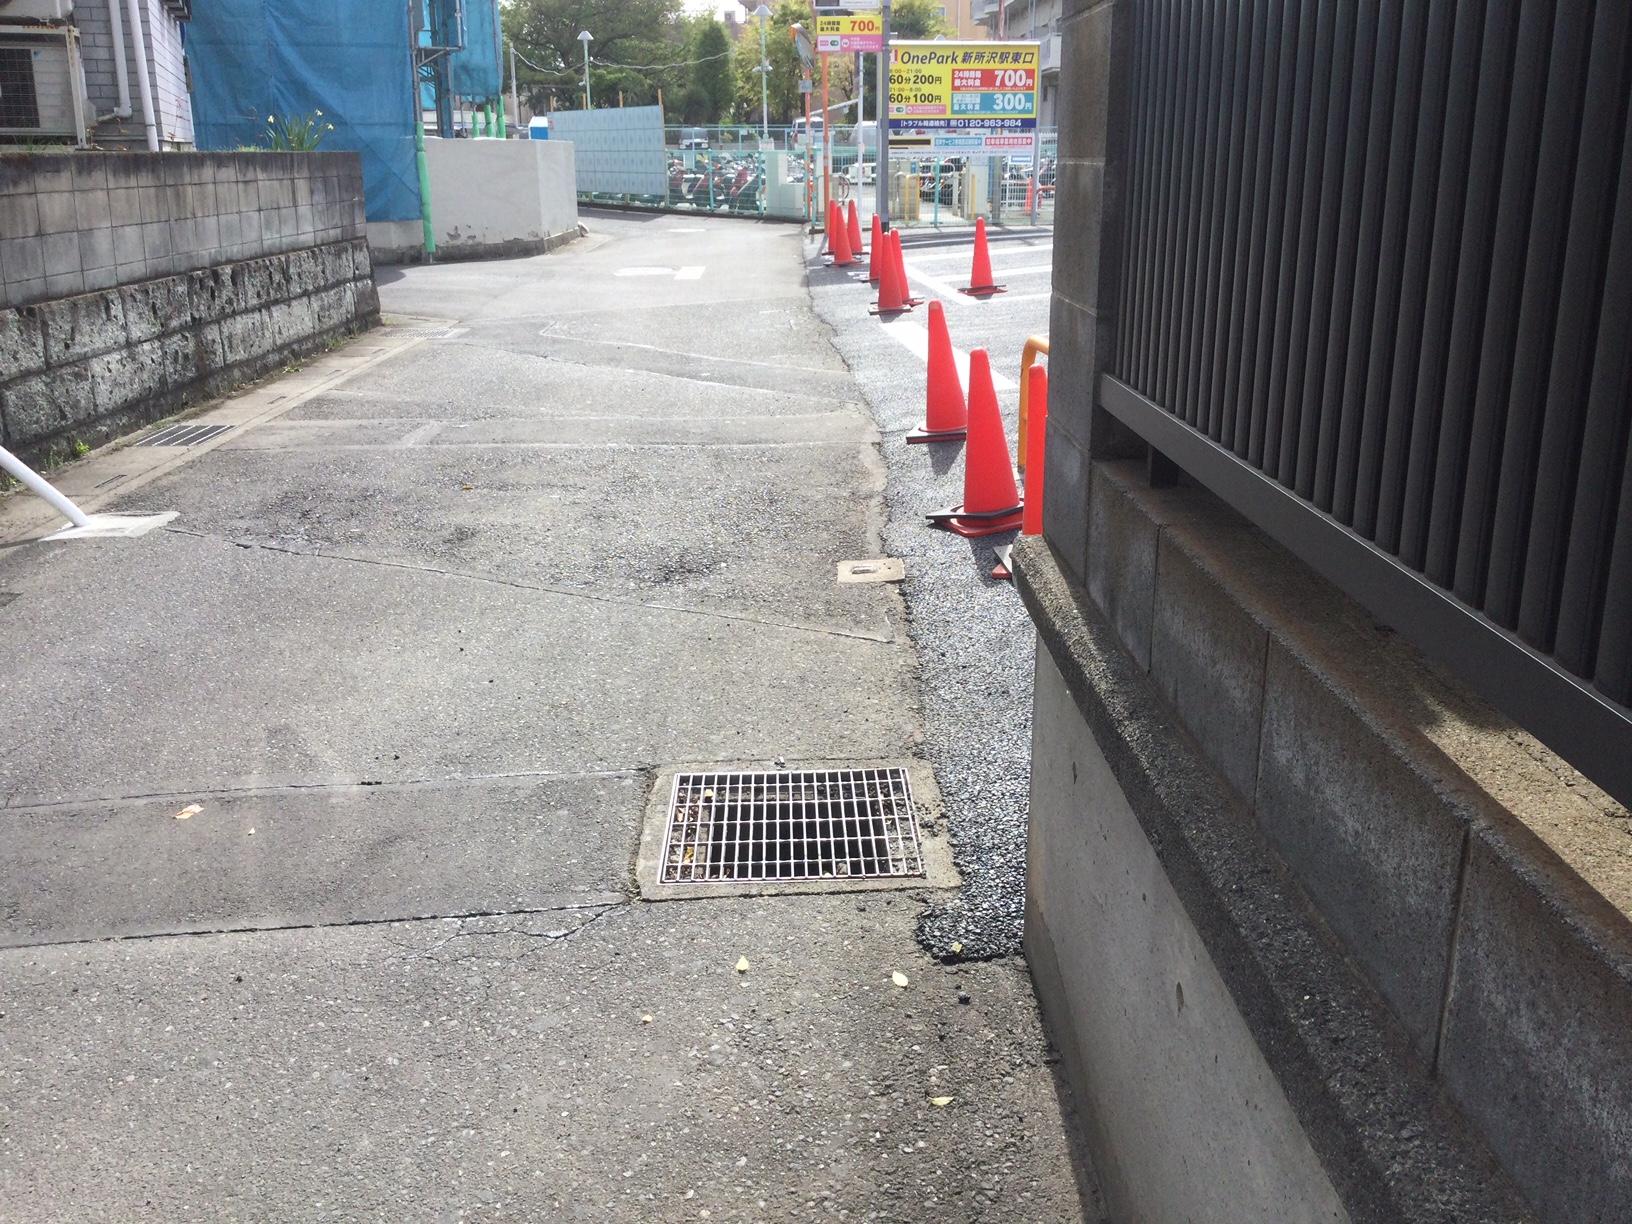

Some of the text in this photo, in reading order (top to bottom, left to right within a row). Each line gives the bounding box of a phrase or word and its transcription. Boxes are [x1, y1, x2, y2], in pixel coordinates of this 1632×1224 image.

[901, 51, 1034, 64] OnePark 新所沢駅東口
[953, 78, 981, 87] 最大料金
[994, 69, 1034, 87] 700円
[953, 103, 980, 111] 最大料金
[993, 93, 1033, 110] 300円
